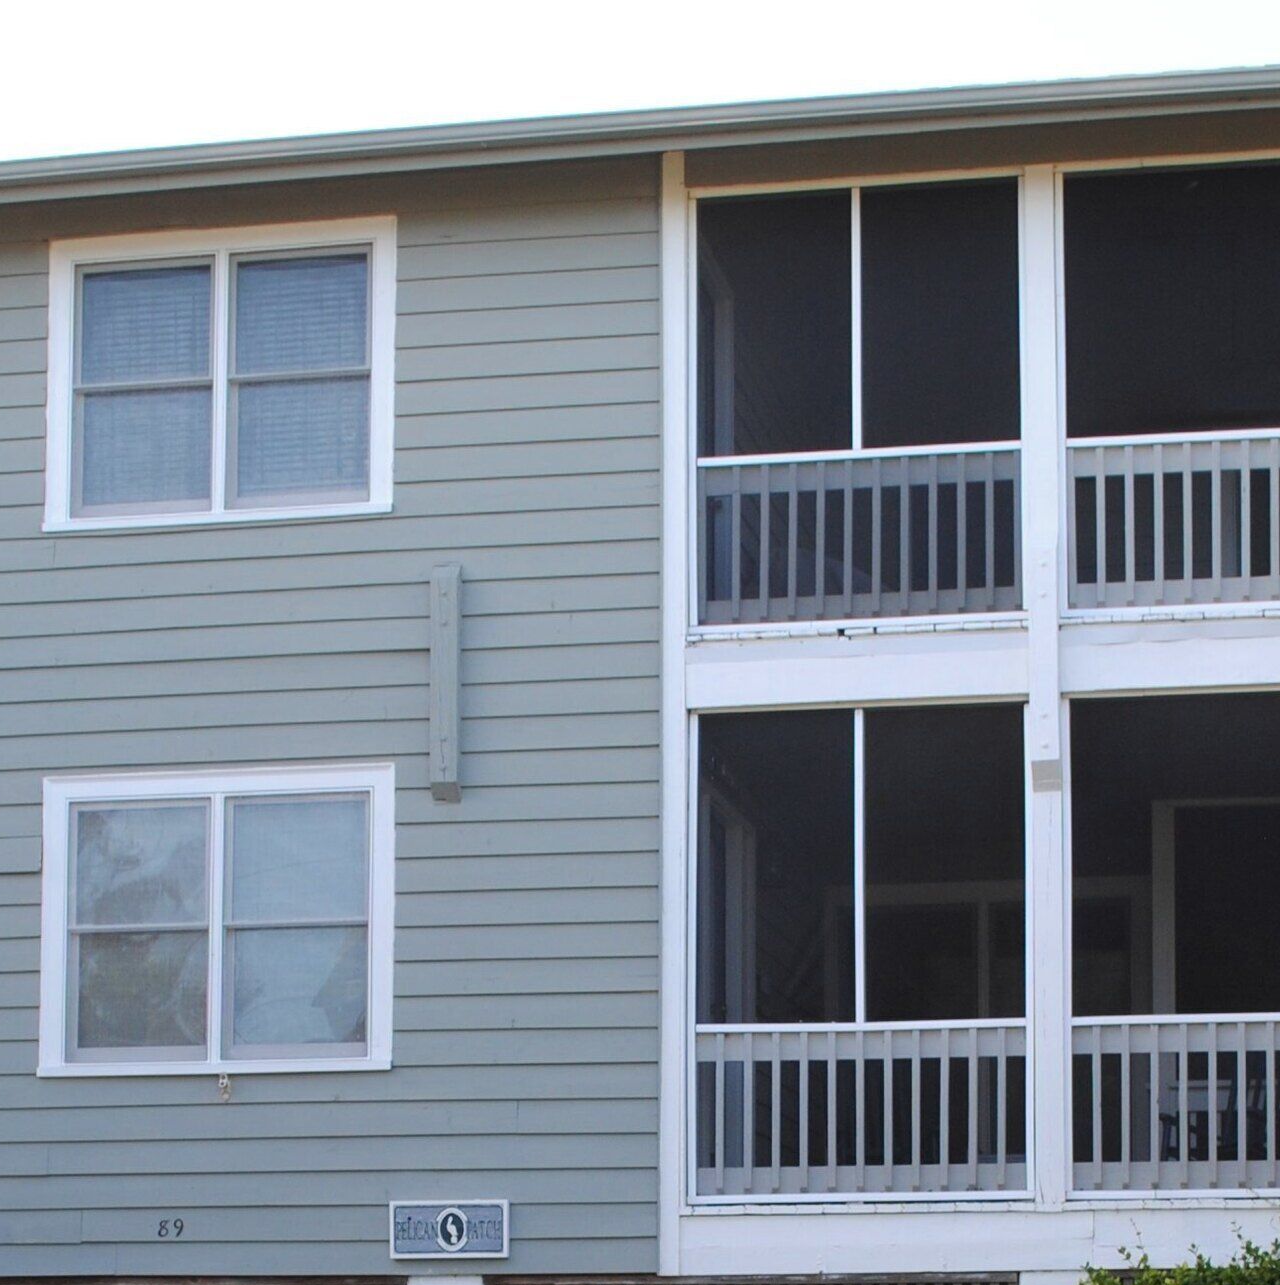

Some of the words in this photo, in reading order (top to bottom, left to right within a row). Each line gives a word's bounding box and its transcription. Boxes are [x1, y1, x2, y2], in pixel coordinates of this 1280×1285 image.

[157, 1218, 184, 1238] 89
[395, 1221, 439, 1241] PELICAN
[467, 1220, 501, 1240] PATCH
